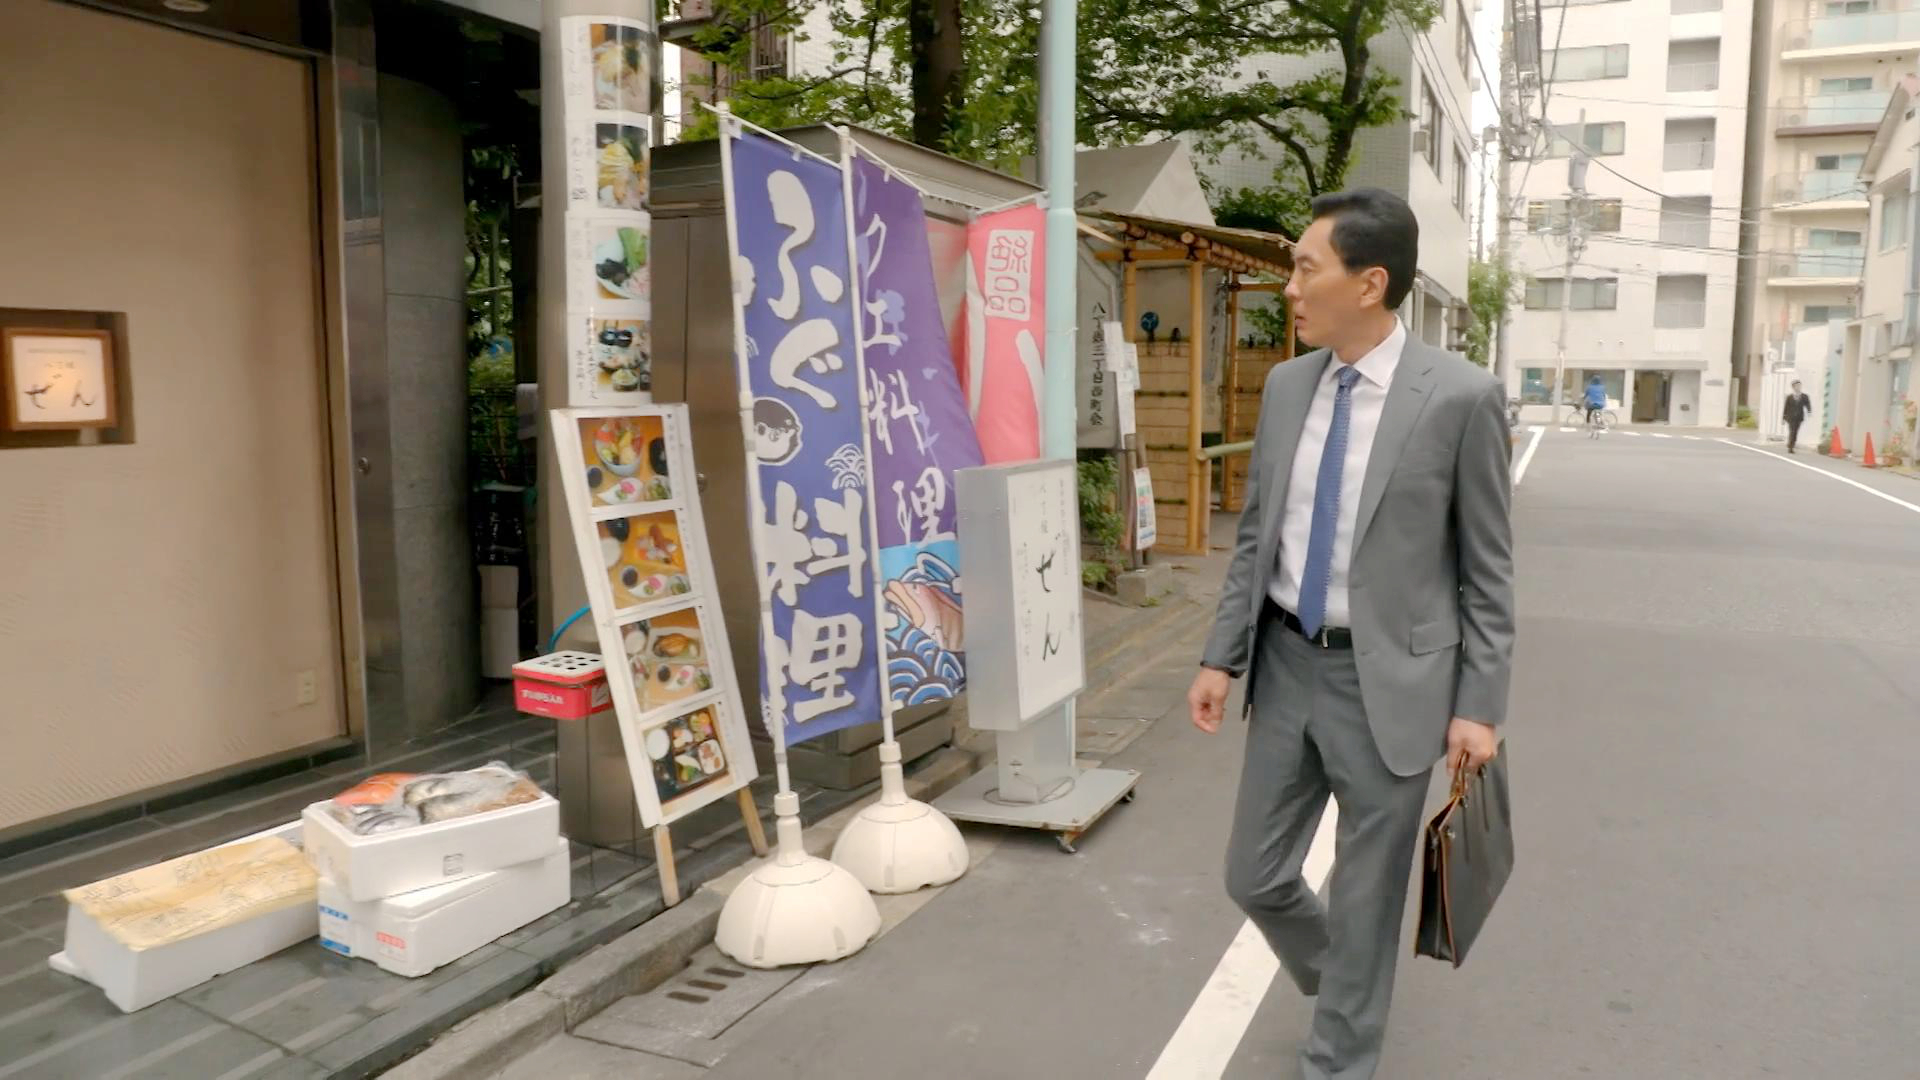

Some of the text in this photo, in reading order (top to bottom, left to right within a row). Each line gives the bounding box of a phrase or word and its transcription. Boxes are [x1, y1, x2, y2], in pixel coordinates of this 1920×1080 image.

[24, 373, 97, 410] ぜん
[738, 169, 872, 725] ふぐ料理
[862, 213, 961, 549] クエ料理
[1035, 533, 1062, 661] ぜん
